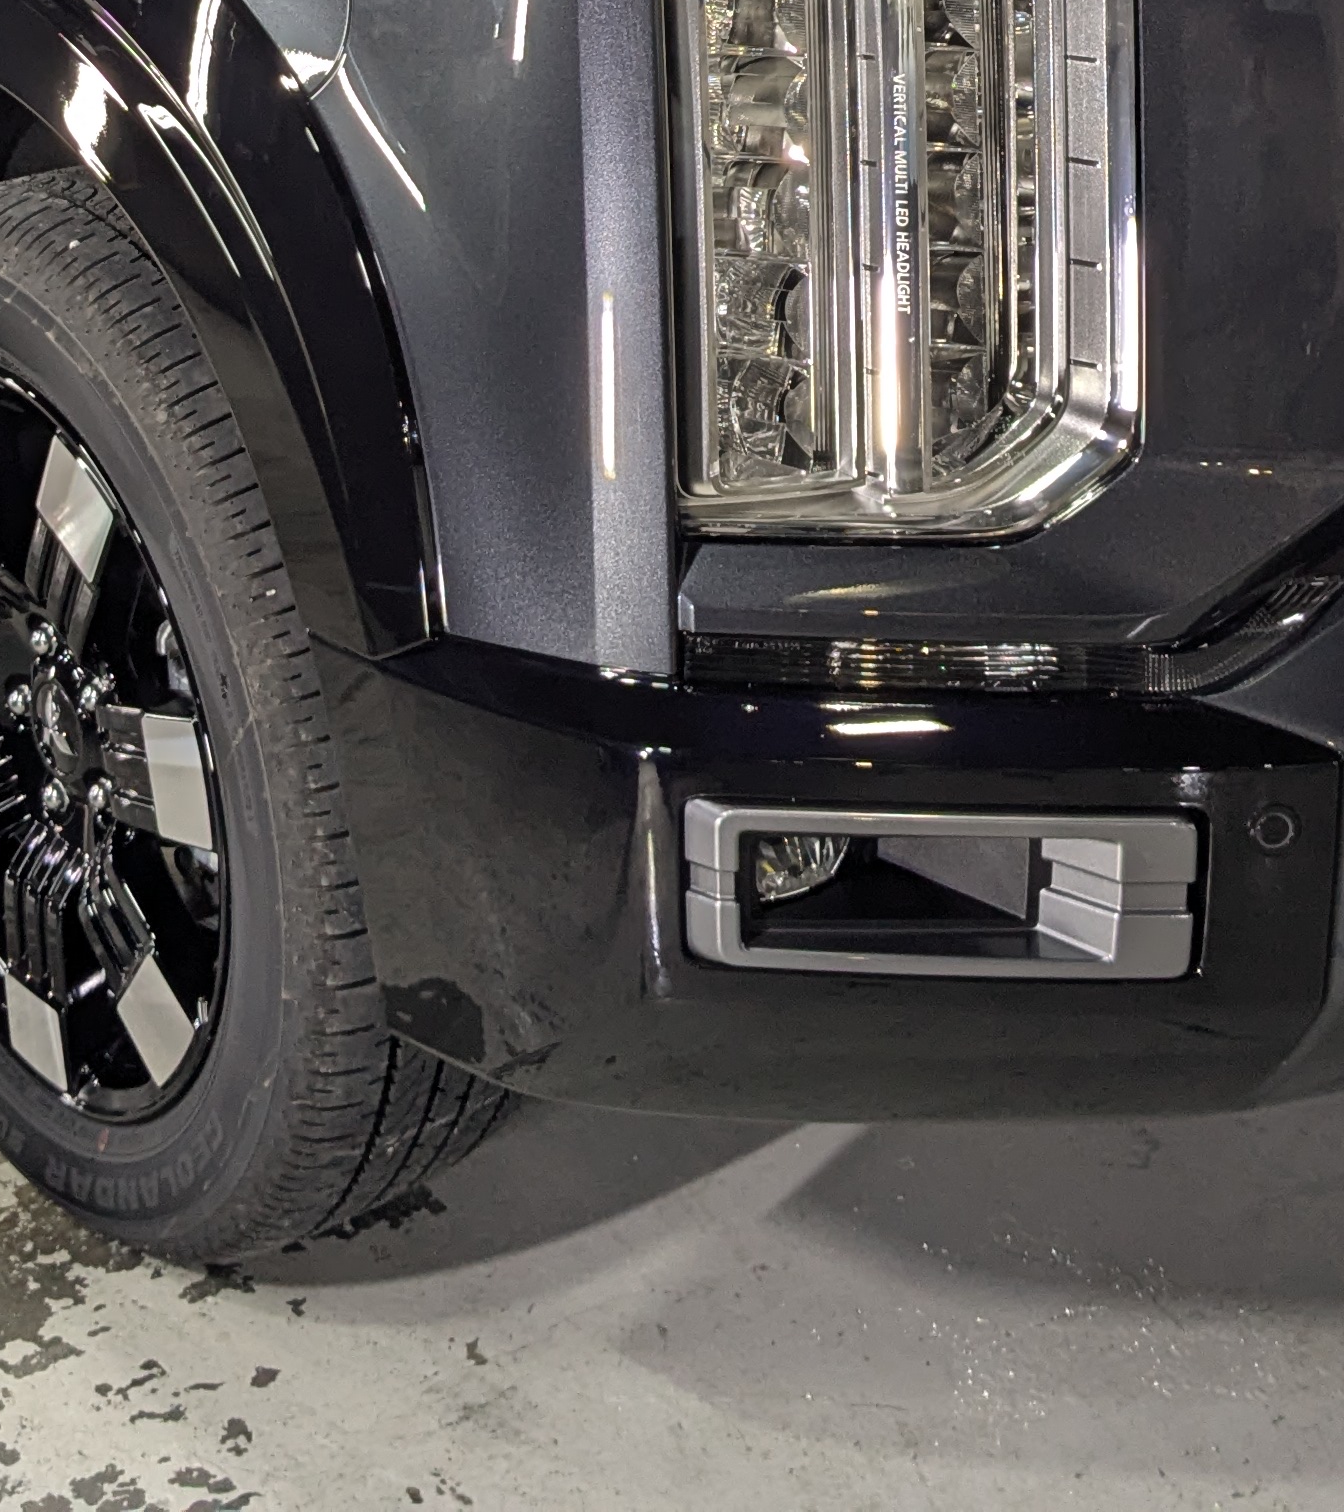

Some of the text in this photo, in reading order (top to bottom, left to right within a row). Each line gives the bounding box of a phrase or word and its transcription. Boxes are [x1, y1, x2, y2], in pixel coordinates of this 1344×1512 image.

[892, 73, 911, 314] VERTICAL MULTI LED HEADLIGHT
